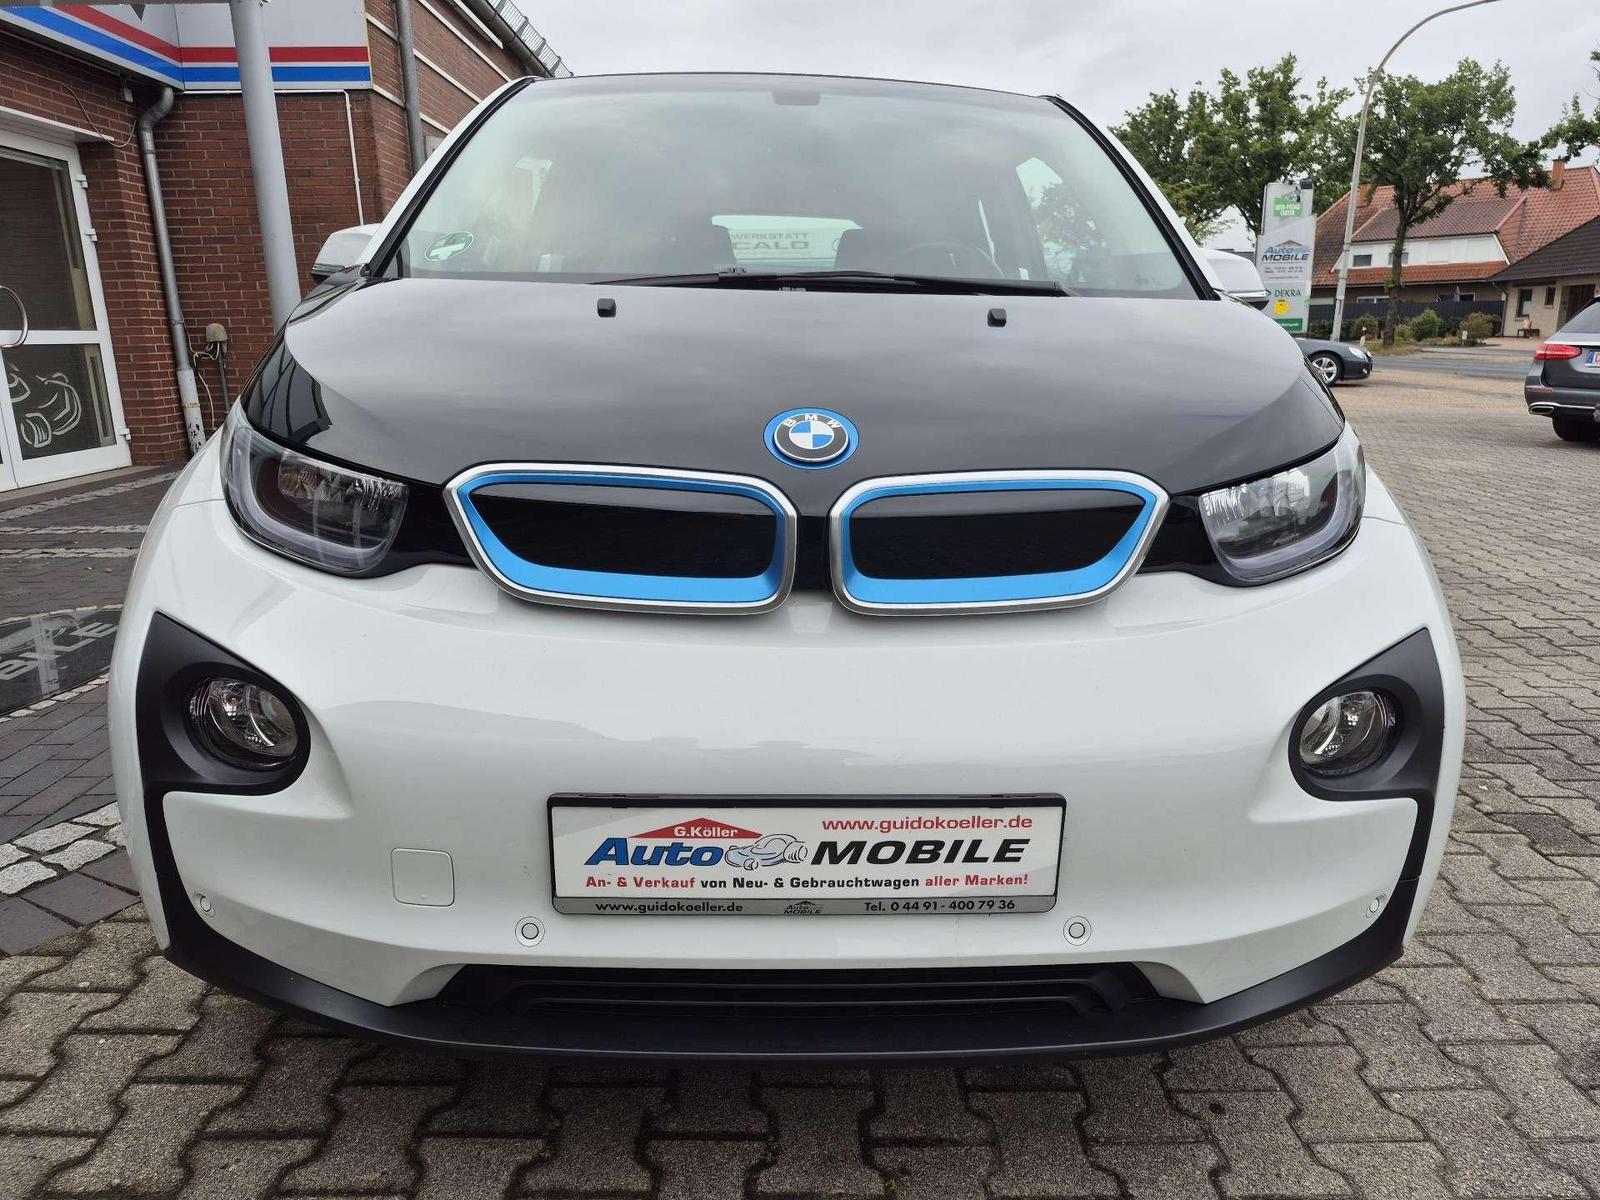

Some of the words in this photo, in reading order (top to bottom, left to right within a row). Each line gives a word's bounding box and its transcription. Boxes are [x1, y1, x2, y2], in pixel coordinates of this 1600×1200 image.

[730, 232, 808, 240] WERKSTATT
[1264, 246, 1295, 254] Auto
[1262, 253, 1309, 261] MOBILE
[1275, 289, 1301, 297] DEKRA
[782, 414, 841, 428] BMW
[821, 814, 1033, 834] www.guidokoeller.de
[673, 825, 738, 838] G.Köller
[583, 837, 724, 867] Auto
[810, 838, 1031, 866] MOBILE
[585, 876, 611, 888] An-
[616, 876, 628, 888] &
[633, 876, 696, 889] Verkauf
[700, 879, 727, 889] von
[732, 877, 768, 889] Neu-
[773, 877, 784, 889] &
[790, 876, 919, 890] Gebrauchtwagen
[925, 875, 960, 887] aller
[964, 873, 1028, 887] Marken!
[595, 901, 743, 914] www.guidokoeller.de
[864, 902, 886, 912] Tel.
[948, 900, 975, 911] 400
